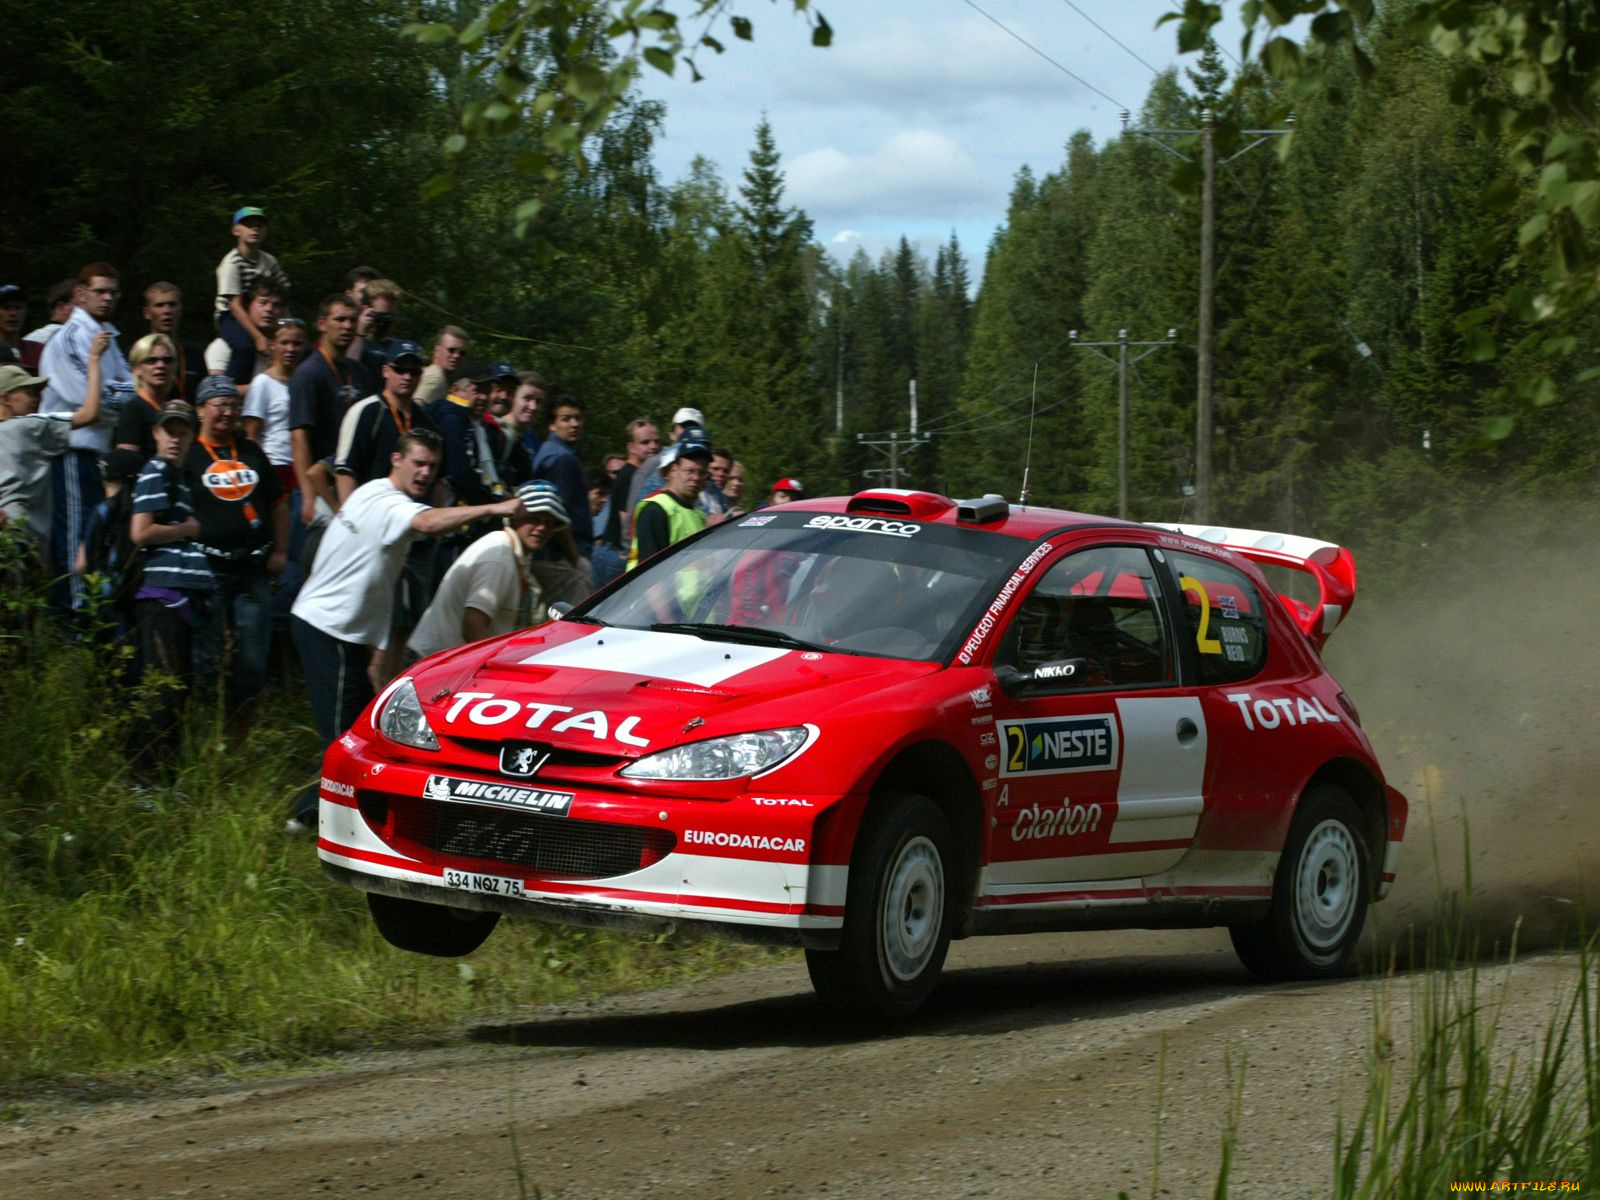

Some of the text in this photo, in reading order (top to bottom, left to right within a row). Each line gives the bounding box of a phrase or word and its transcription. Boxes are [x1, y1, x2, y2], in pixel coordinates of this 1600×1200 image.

[803, 515, 921, 538] sparco
[965, 542, 1053, 656] PEUGEOT FINANCIAL SERVICES
[1179, 576, 1222, 654] 2
[1221, 627, 1248, 643] BURNS
[1226, 645, 1244, 661] REID
[1034, 664, 1075, 679] NIKKO
[445, 692, 650, 747] TOTAL
[1226, 693, 1340, 731] TOTAL
[1008, 726, 1107, 771] 2 NESTE
[454, 781, 573, 810] MICHELIN
[751, 797, 814, 807] TOTAL
[997, 784, 1009, 806] A
[1011, 797, 1101, 842] clarion
[684, 829, 805, 852] EURODATACAR
[447, 872, 520, 896] 334 NQZ 75
